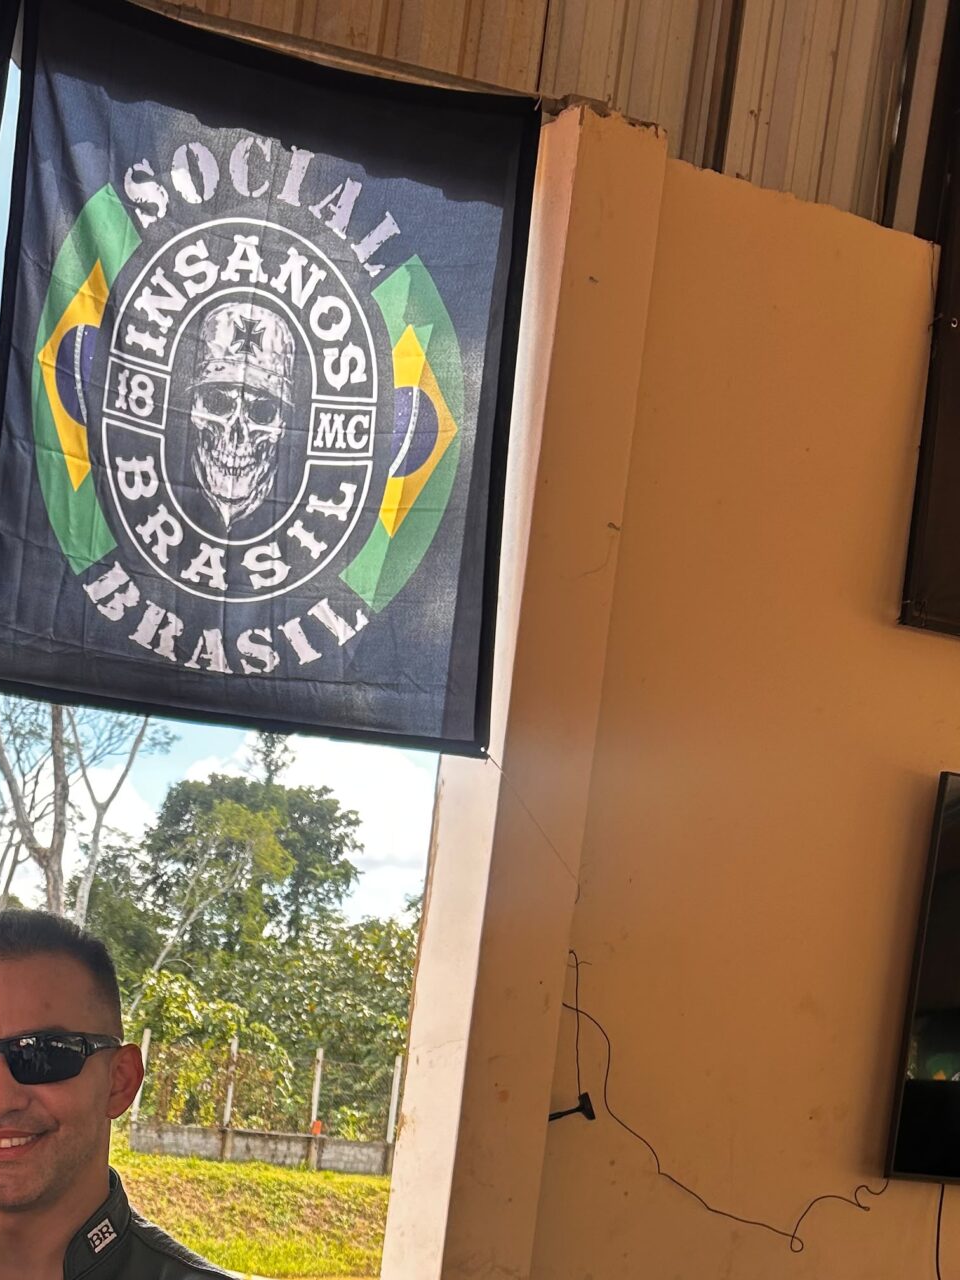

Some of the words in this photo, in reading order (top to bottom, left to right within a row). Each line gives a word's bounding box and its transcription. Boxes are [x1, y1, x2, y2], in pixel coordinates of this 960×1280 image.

[123, 136, 402, 279] SOCIAL
[126, 234, 367, 392] INSANOS
[114, 369, 156, 418] 18
[313, 409, 370, 451] MC
[115, 456, 358, 590] BRASIL
[82, 560, 371, 675] BRASIL
[89, 1223, 114, 1249] BR
